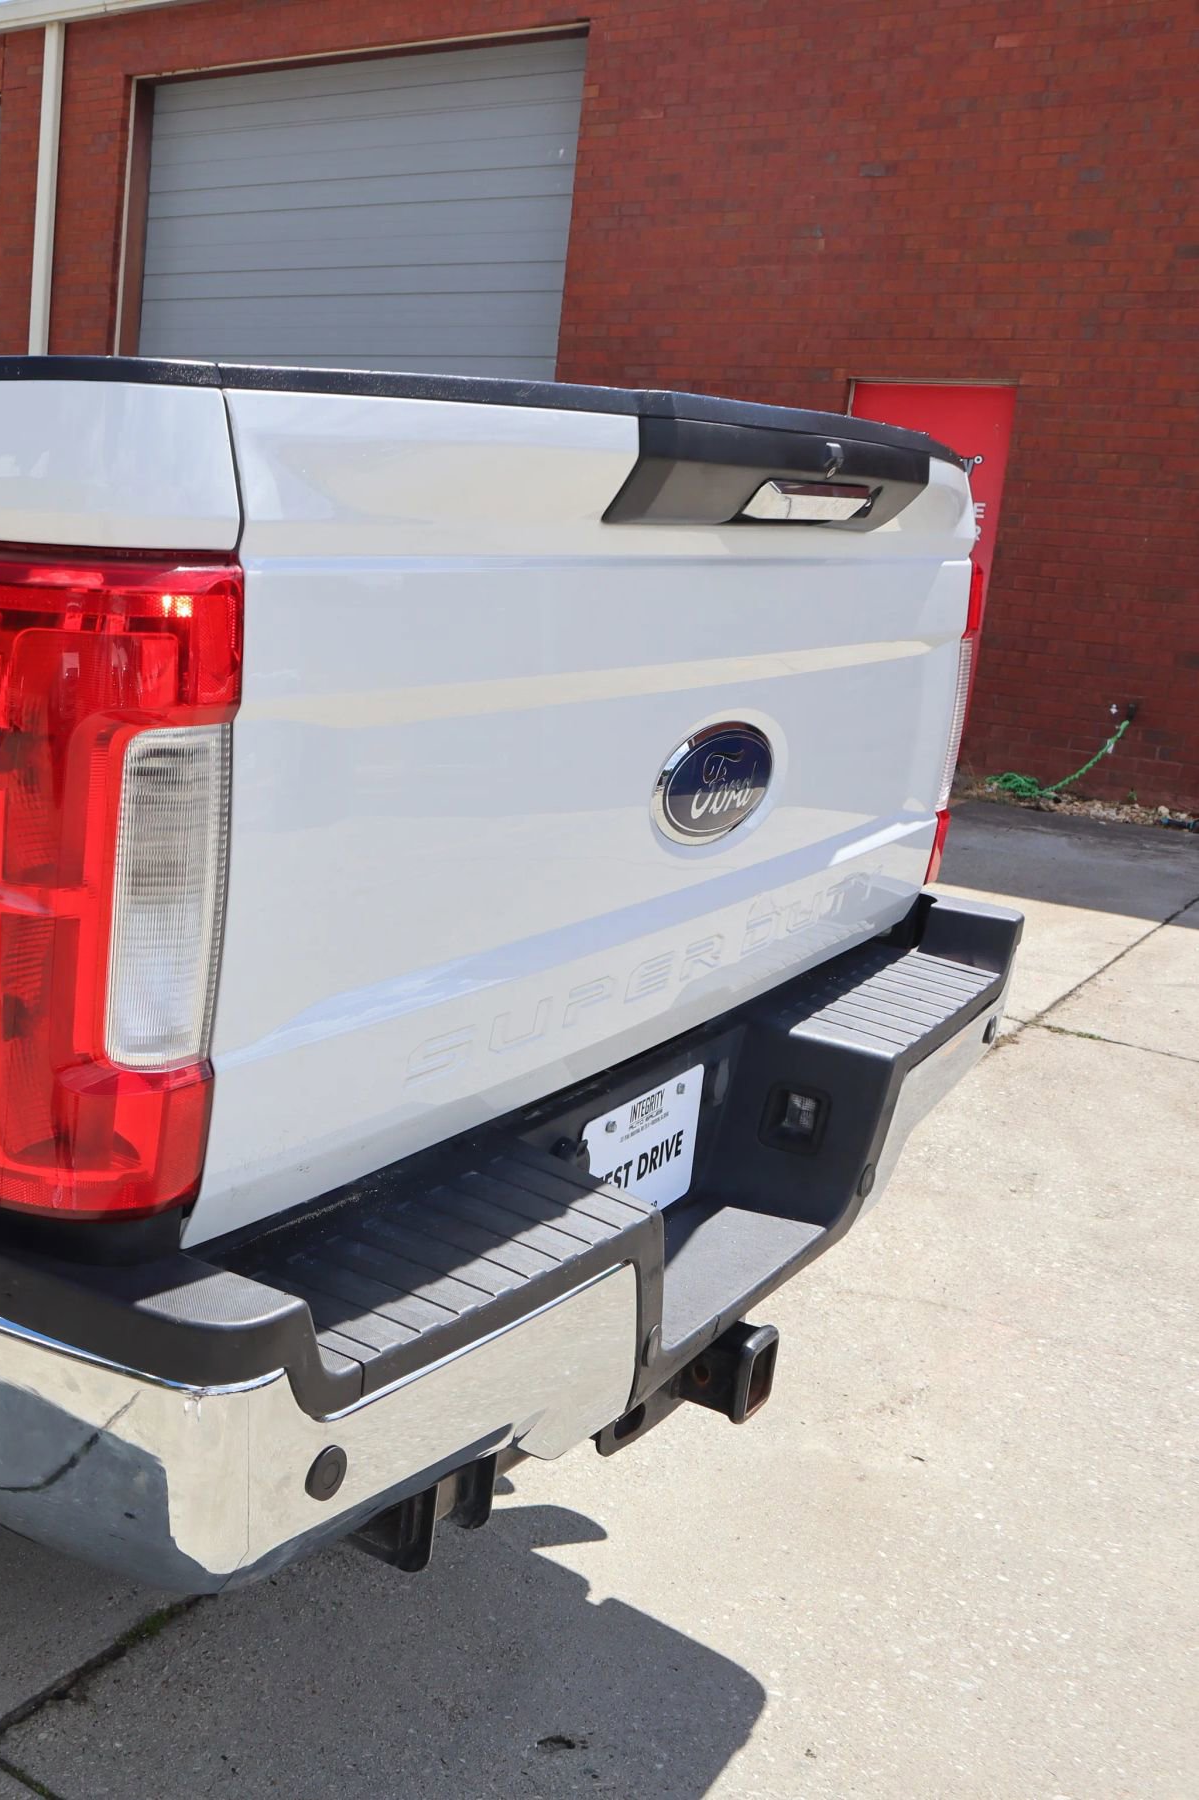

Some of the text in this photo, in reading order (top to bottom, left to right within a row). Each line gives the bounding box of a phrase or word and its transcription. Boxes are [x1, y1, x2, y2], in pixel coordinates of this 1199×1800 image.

[690, 749, 758, 819] Ford
[402, 863, 884, 1088] SUPER DUTY
[629, 1088, 665, 1123] INTEGRITY
[601, 1129, 684, 1189] EST DRIVE
